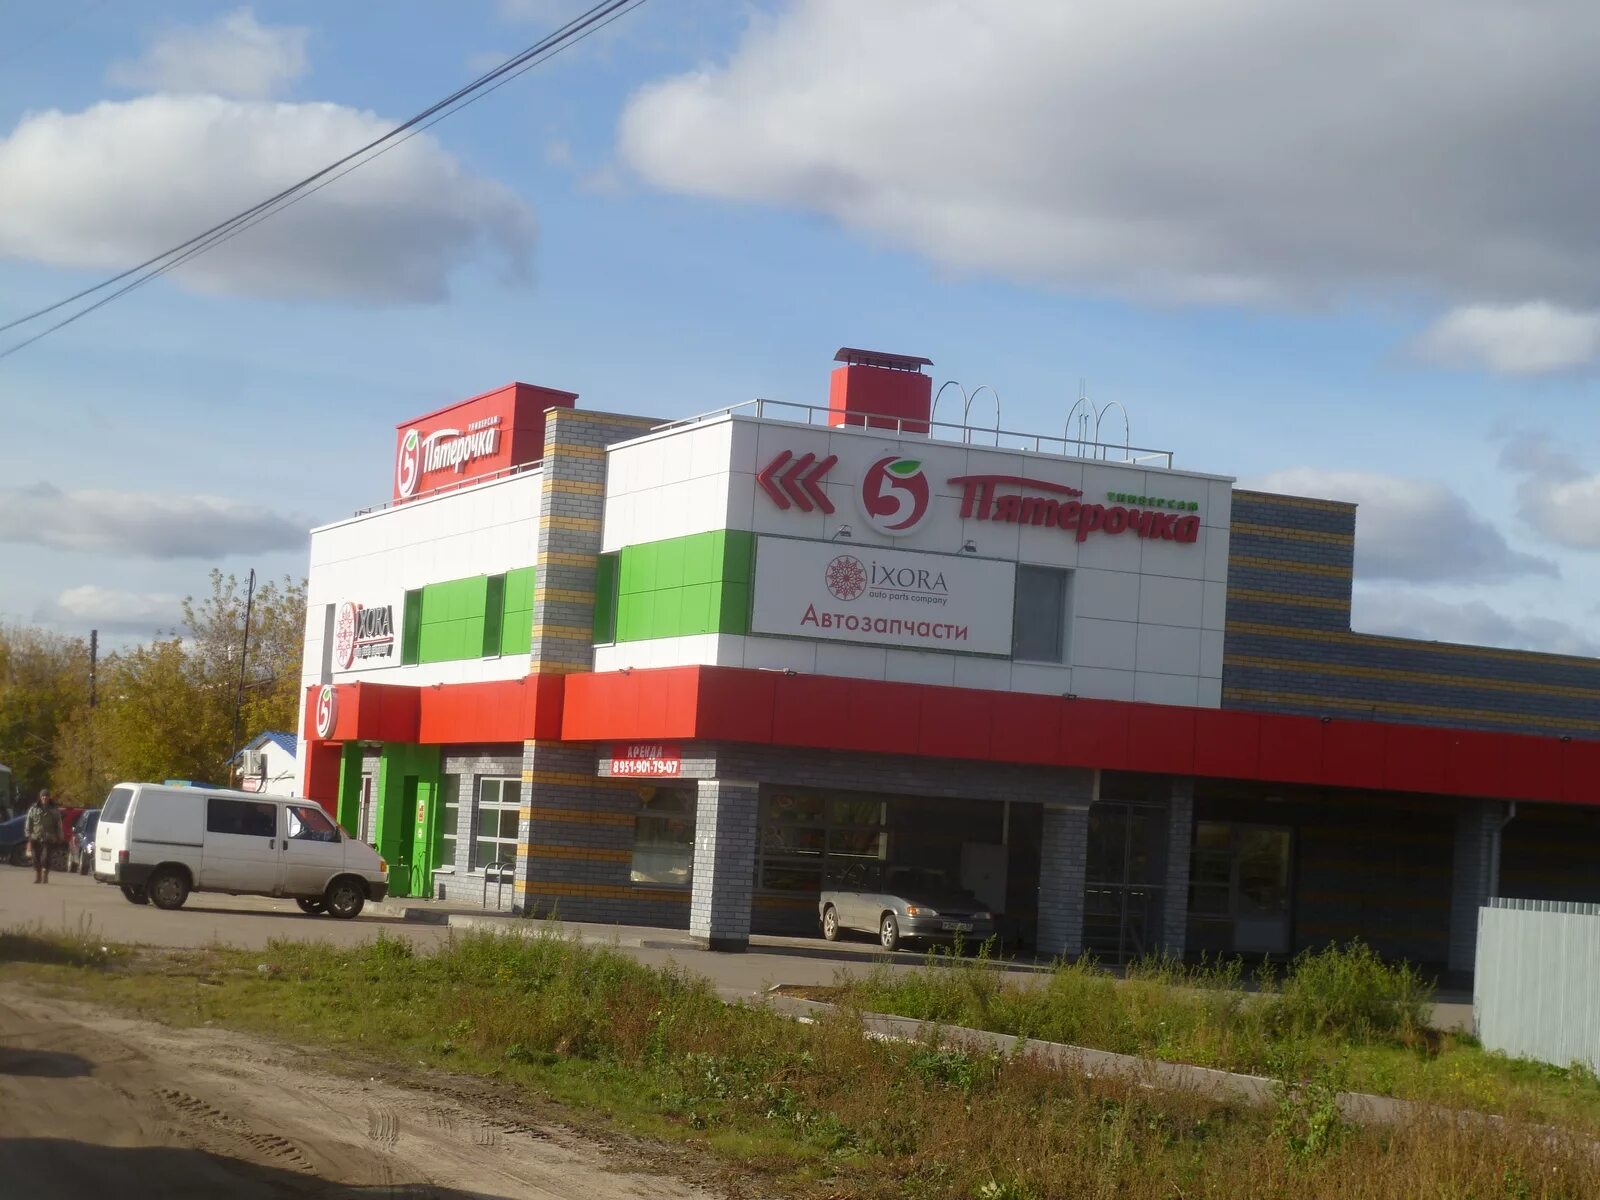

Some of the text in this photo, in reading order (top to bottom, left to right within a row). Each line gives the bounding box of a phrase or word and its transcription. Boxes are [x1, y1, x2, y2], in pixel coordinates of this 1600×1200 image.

[422, 429, 498, 473] Пятерочка
[868, 458, 1200, 543] 5 Пятерочка
[869, 591, 948, 606] auto parts company
[800, 603, 969, 641] Автозапчасти
[627, 746, 663, 759] АРЕНДА
